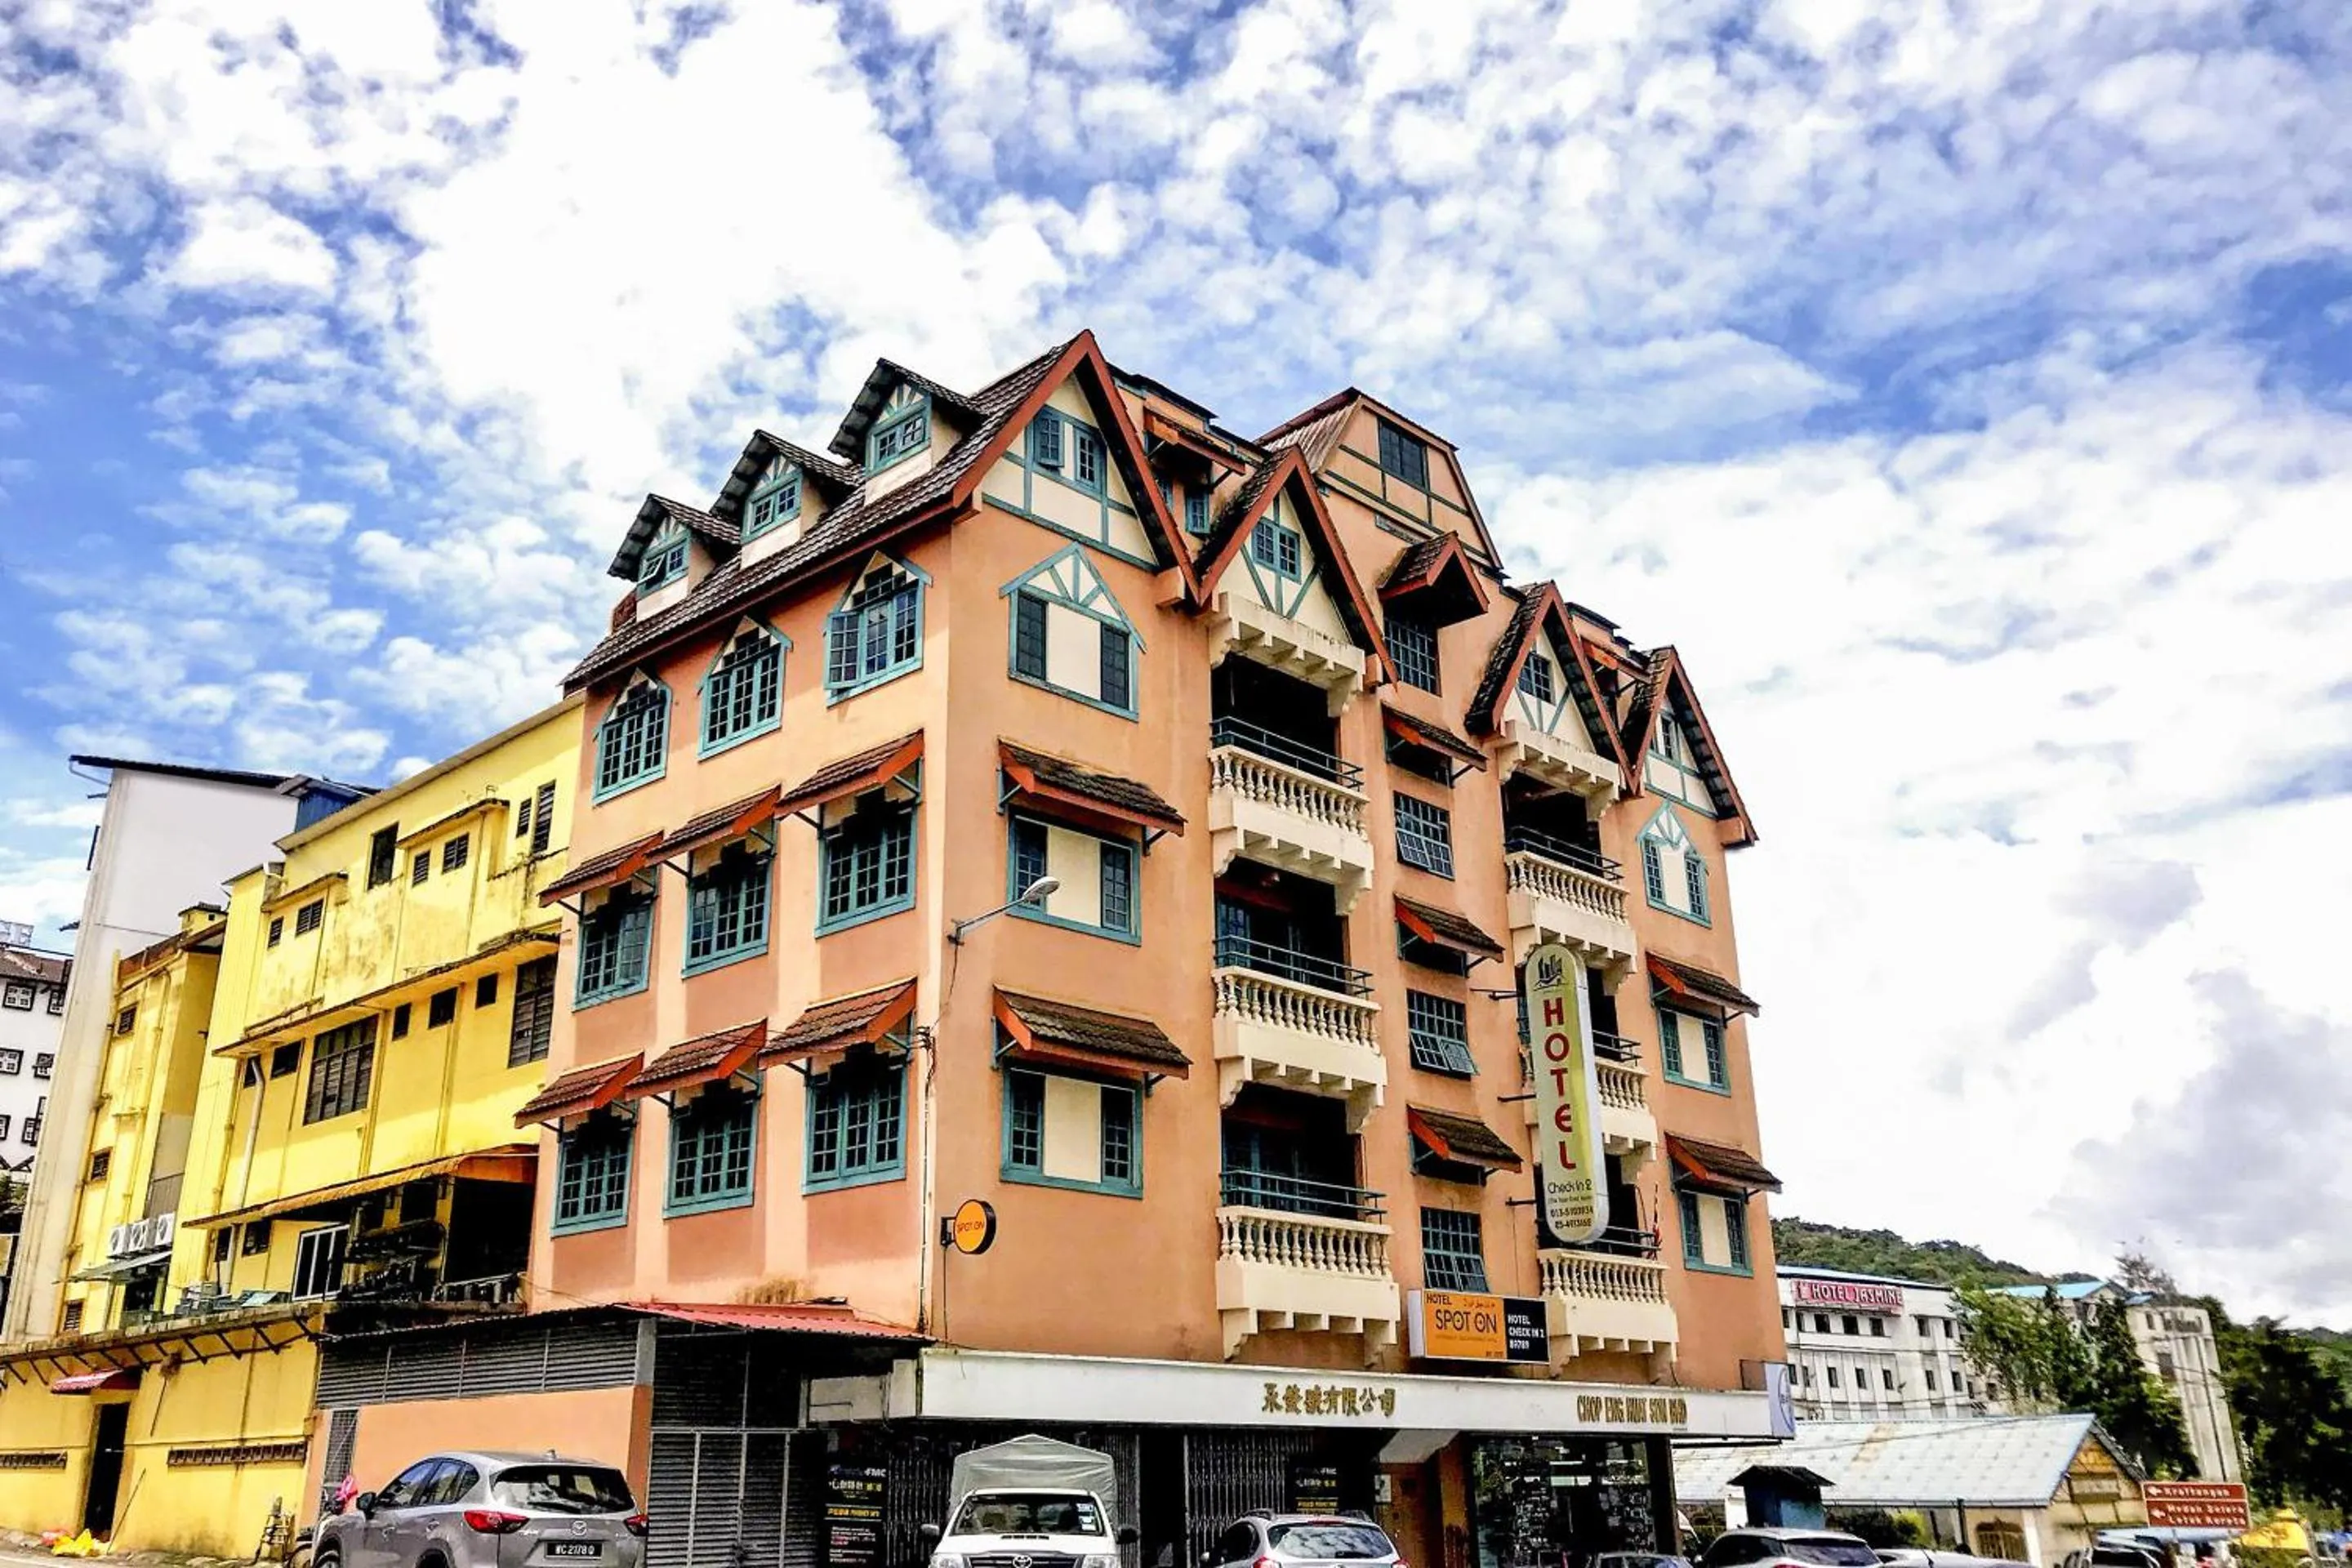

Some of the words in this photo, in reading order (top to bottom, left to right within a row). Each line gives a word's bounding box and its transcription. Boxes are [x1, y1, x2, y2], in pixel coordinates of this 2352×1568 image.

[1542, 996, 1577, 1171] HOTEL
[1426, 1293, 1452, 1306] HOTEL
[1811, 1283, 1852, 1301] HOTEL
[1854, 1286, 1904, 1306] JASMINE
[1436, 1308, 1472, 1332] SPOT
[1473, 1311, 1498, 1334] ON
[1508, 1314, 1531, 1325] HOTEL
[1508, 1326, 1531, 1338] CHECK
[1531, 1328, 1539, 1339] IN
[1576, 1395, 1602, 1423] CHOP
[1604, 1396, 1624, 1423] ENG
